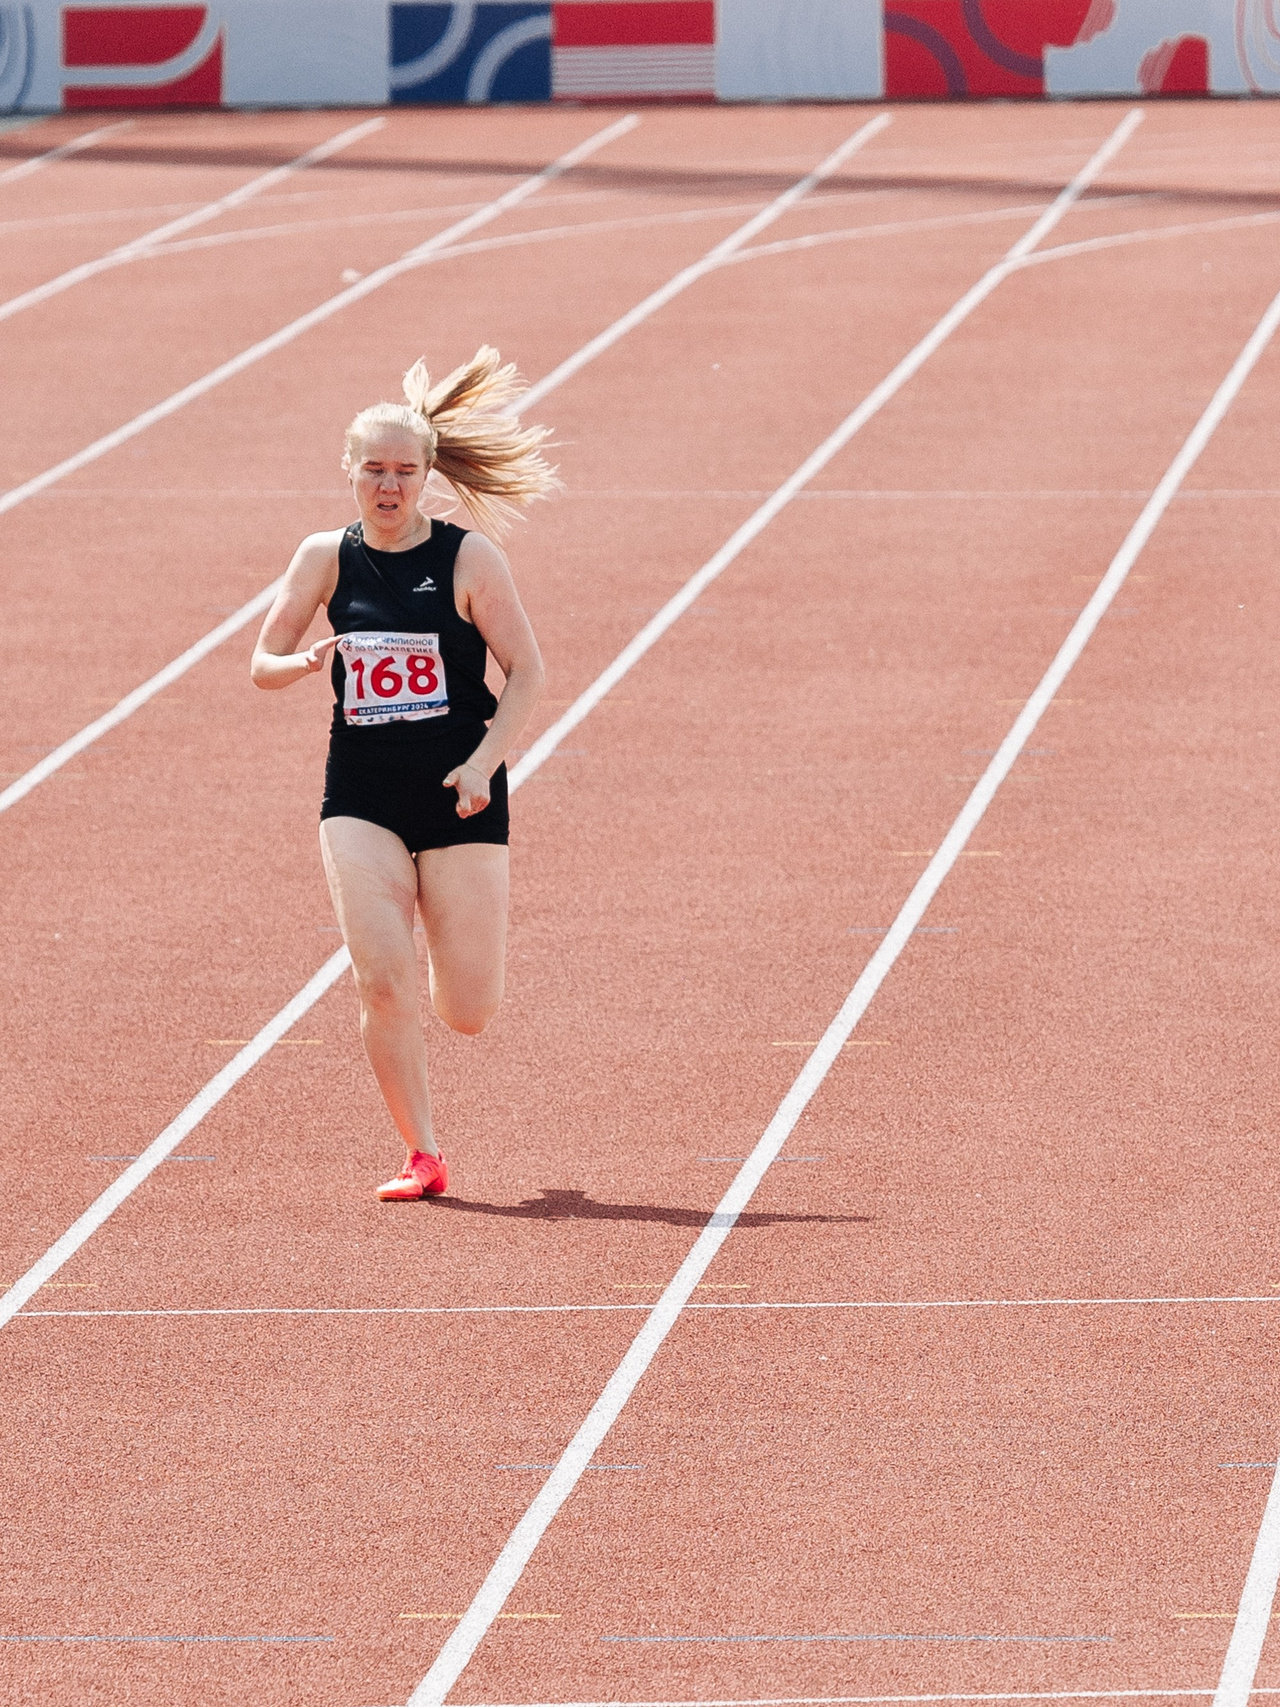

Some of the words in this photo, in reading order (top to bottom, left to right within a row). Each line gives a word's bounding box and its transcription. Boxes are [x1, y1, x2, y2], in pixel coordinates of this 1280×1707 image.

[350, 654, 438, 700] 168
[358, 703, 410, 715] ЕКАТЕРИНБУРГ
[411, 702, 429, 711] 2024
